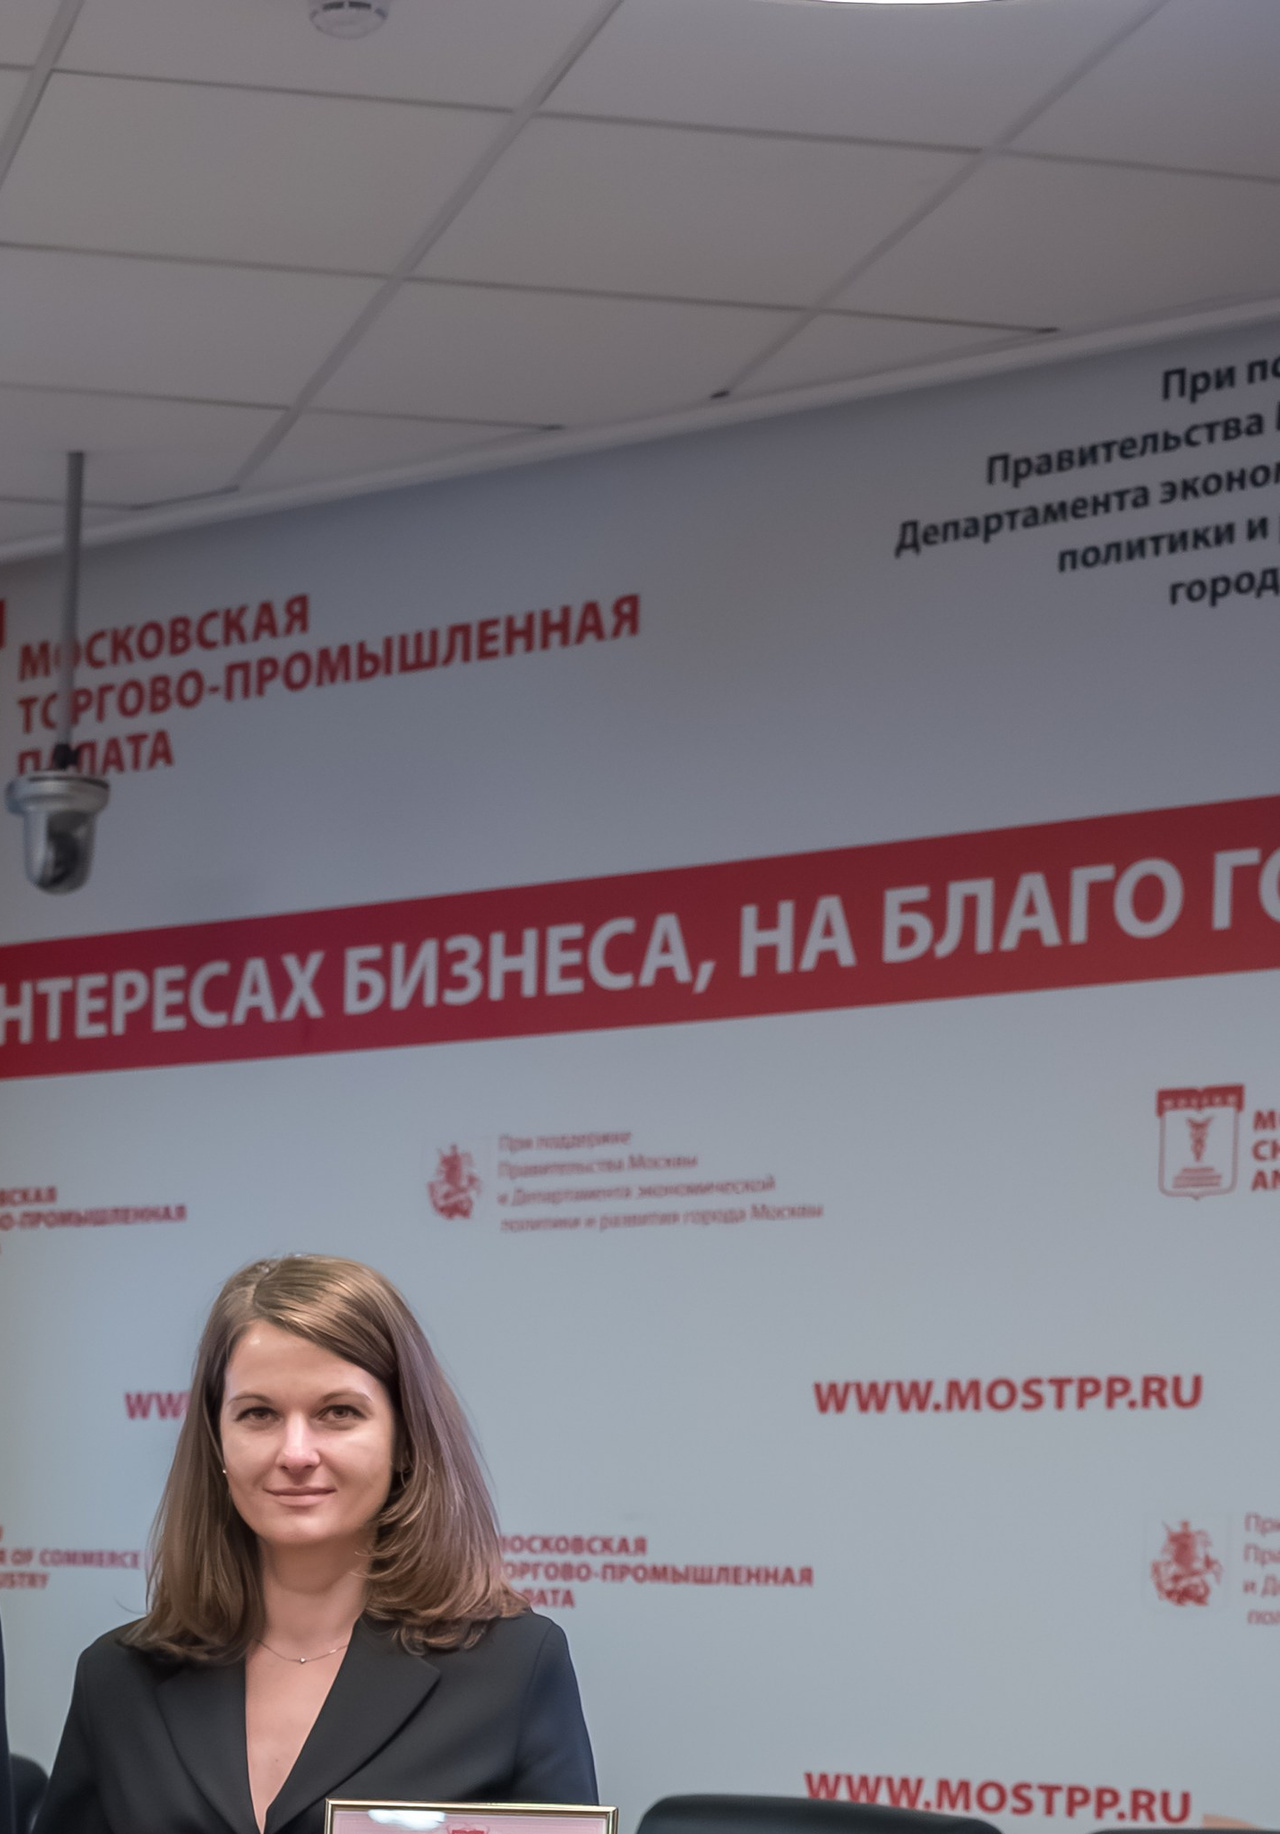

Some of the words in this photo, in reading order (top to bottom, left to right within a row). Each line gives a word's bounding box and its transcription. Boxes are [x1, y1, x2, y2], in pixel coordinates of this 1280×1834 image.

[1162, 366, 1236, 403] При
[986, 412, 1264, 488] Правительства
[895, 485, 1150, 558] Департамента
[1159, 461, 1280, 505] эконо
[1058, 522, 1235, 573] политики
[1246, 516, 1269, 542] и
[18, 729, 175, 776] ПЛАТА
[342, 913, 716, 1016] БИЗНЕСА,
[739, 896, 857, 979] НА
[881, 858, 1184, 963] БЛАГО
[814, 1374, 1203, 1415] WWW.MOSTPP.RU
[500, 1561, 814, 1589] ОРГОВО-ПРОМЫШЛЕННАЯ
[804, 1772, 1191, 1823] WWW.MOSTPP.RU
